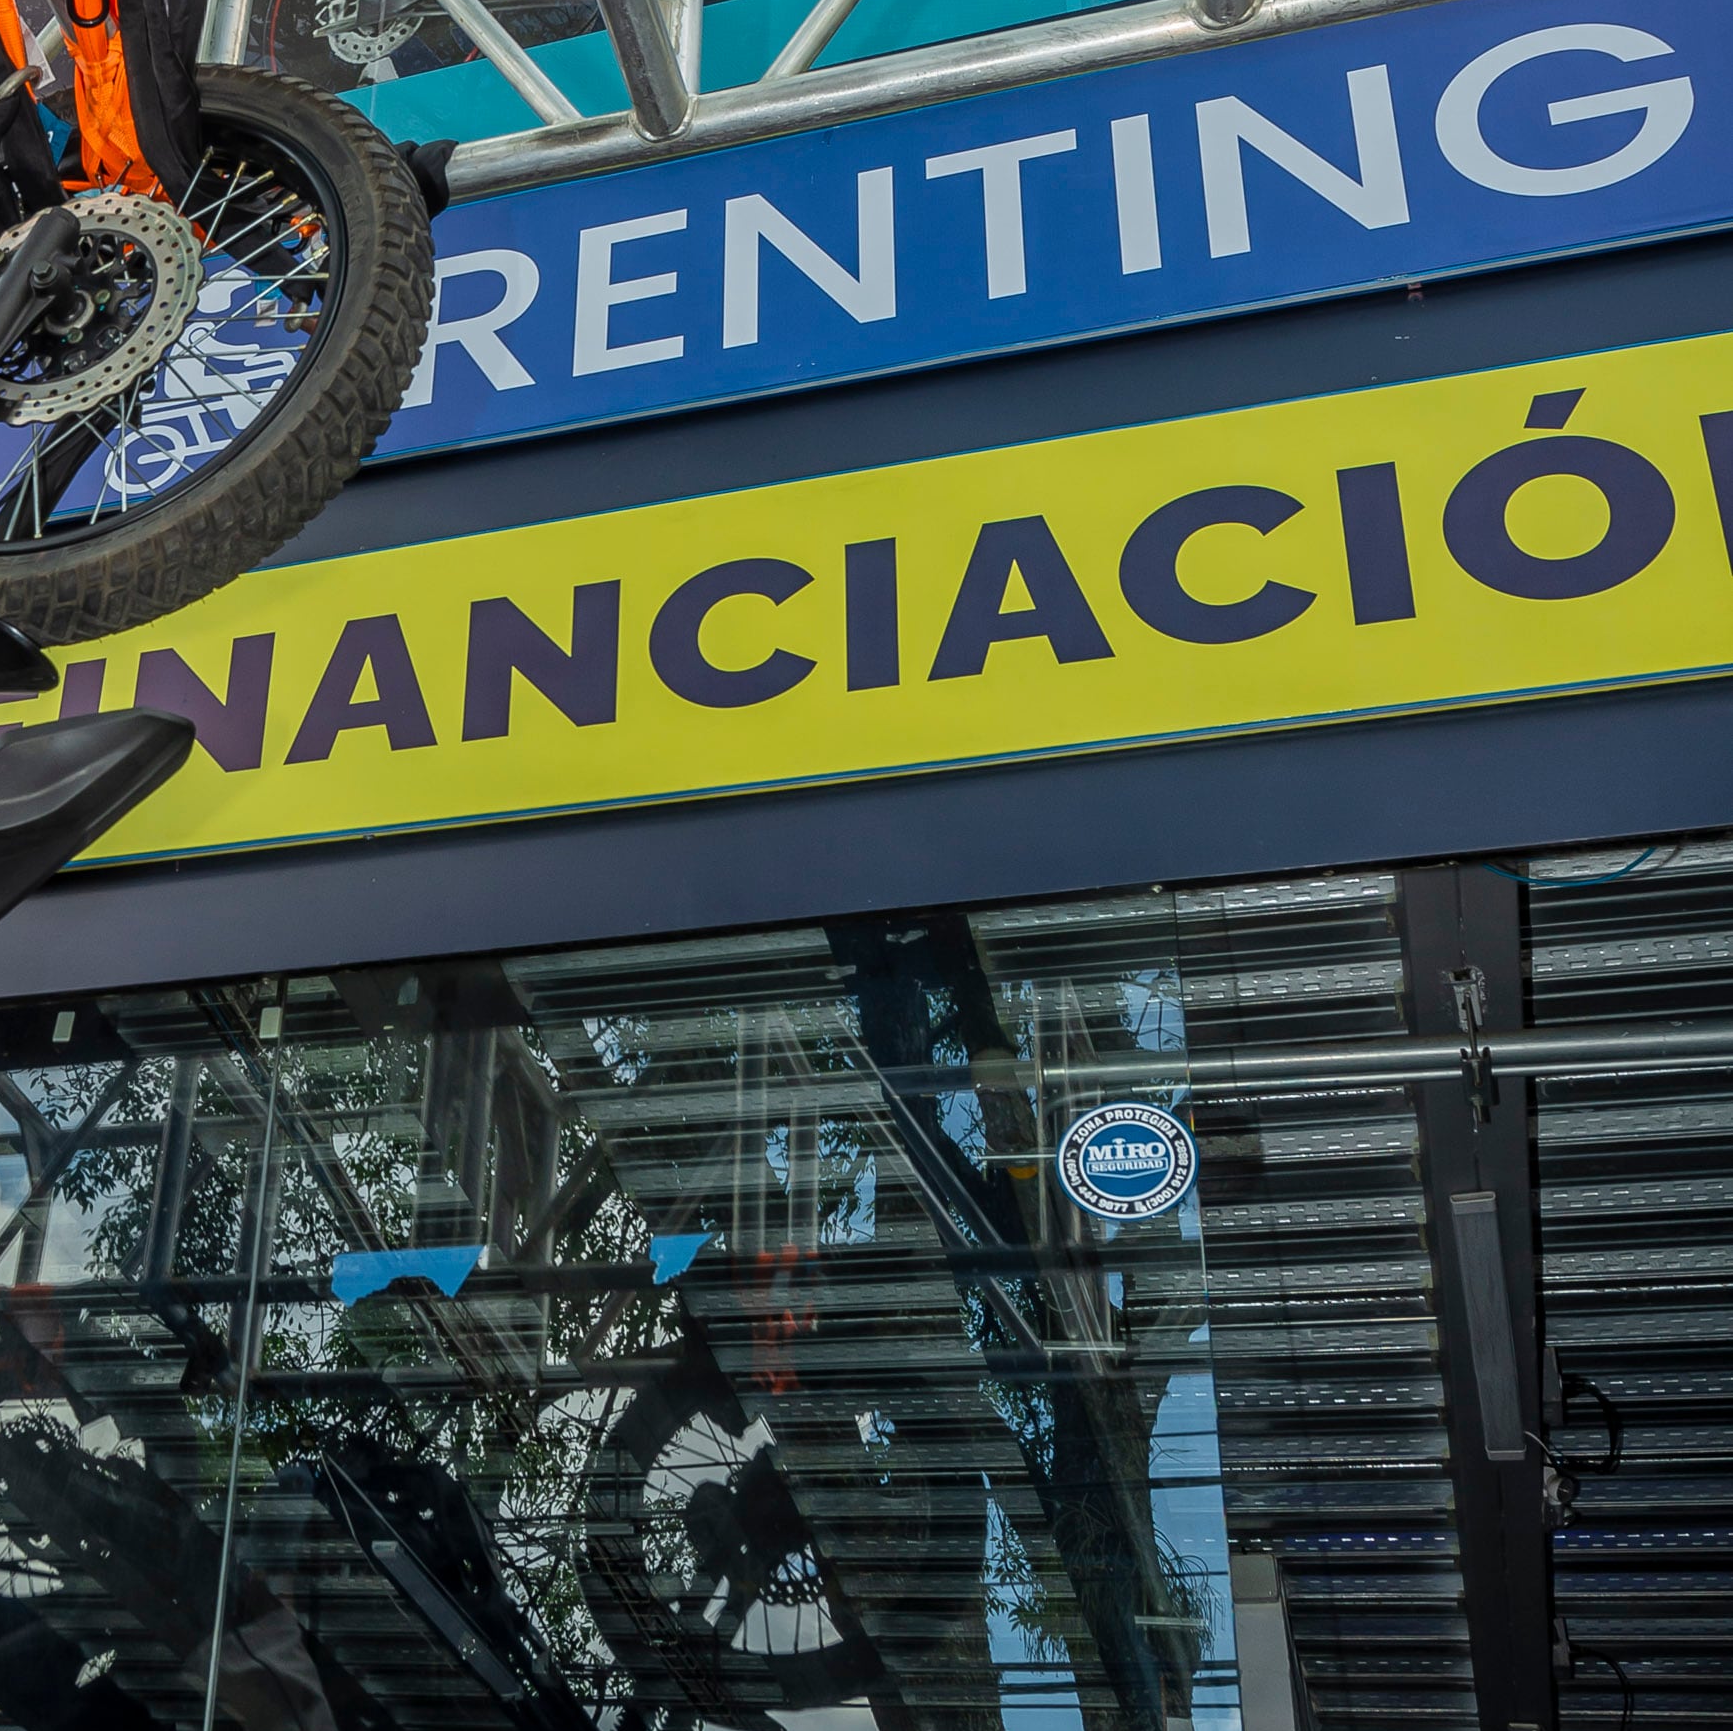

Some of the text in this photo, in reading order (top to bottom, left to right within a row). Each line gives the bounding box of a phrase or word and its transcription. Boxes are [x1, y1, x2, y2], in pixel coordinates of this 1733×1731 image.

[404, 22, 1695, 407] RENTING
[1072, 1109, 1177, 1144] ZONA PROTEGIDA
[1087, 1138, 1166, 1161] MIRO
[1091, 1160, 1163, 1172] SEGURIDAD
[1078, 1186, 1097, 1203] 444
[1146, 1187, 1176, 1210] (300)
